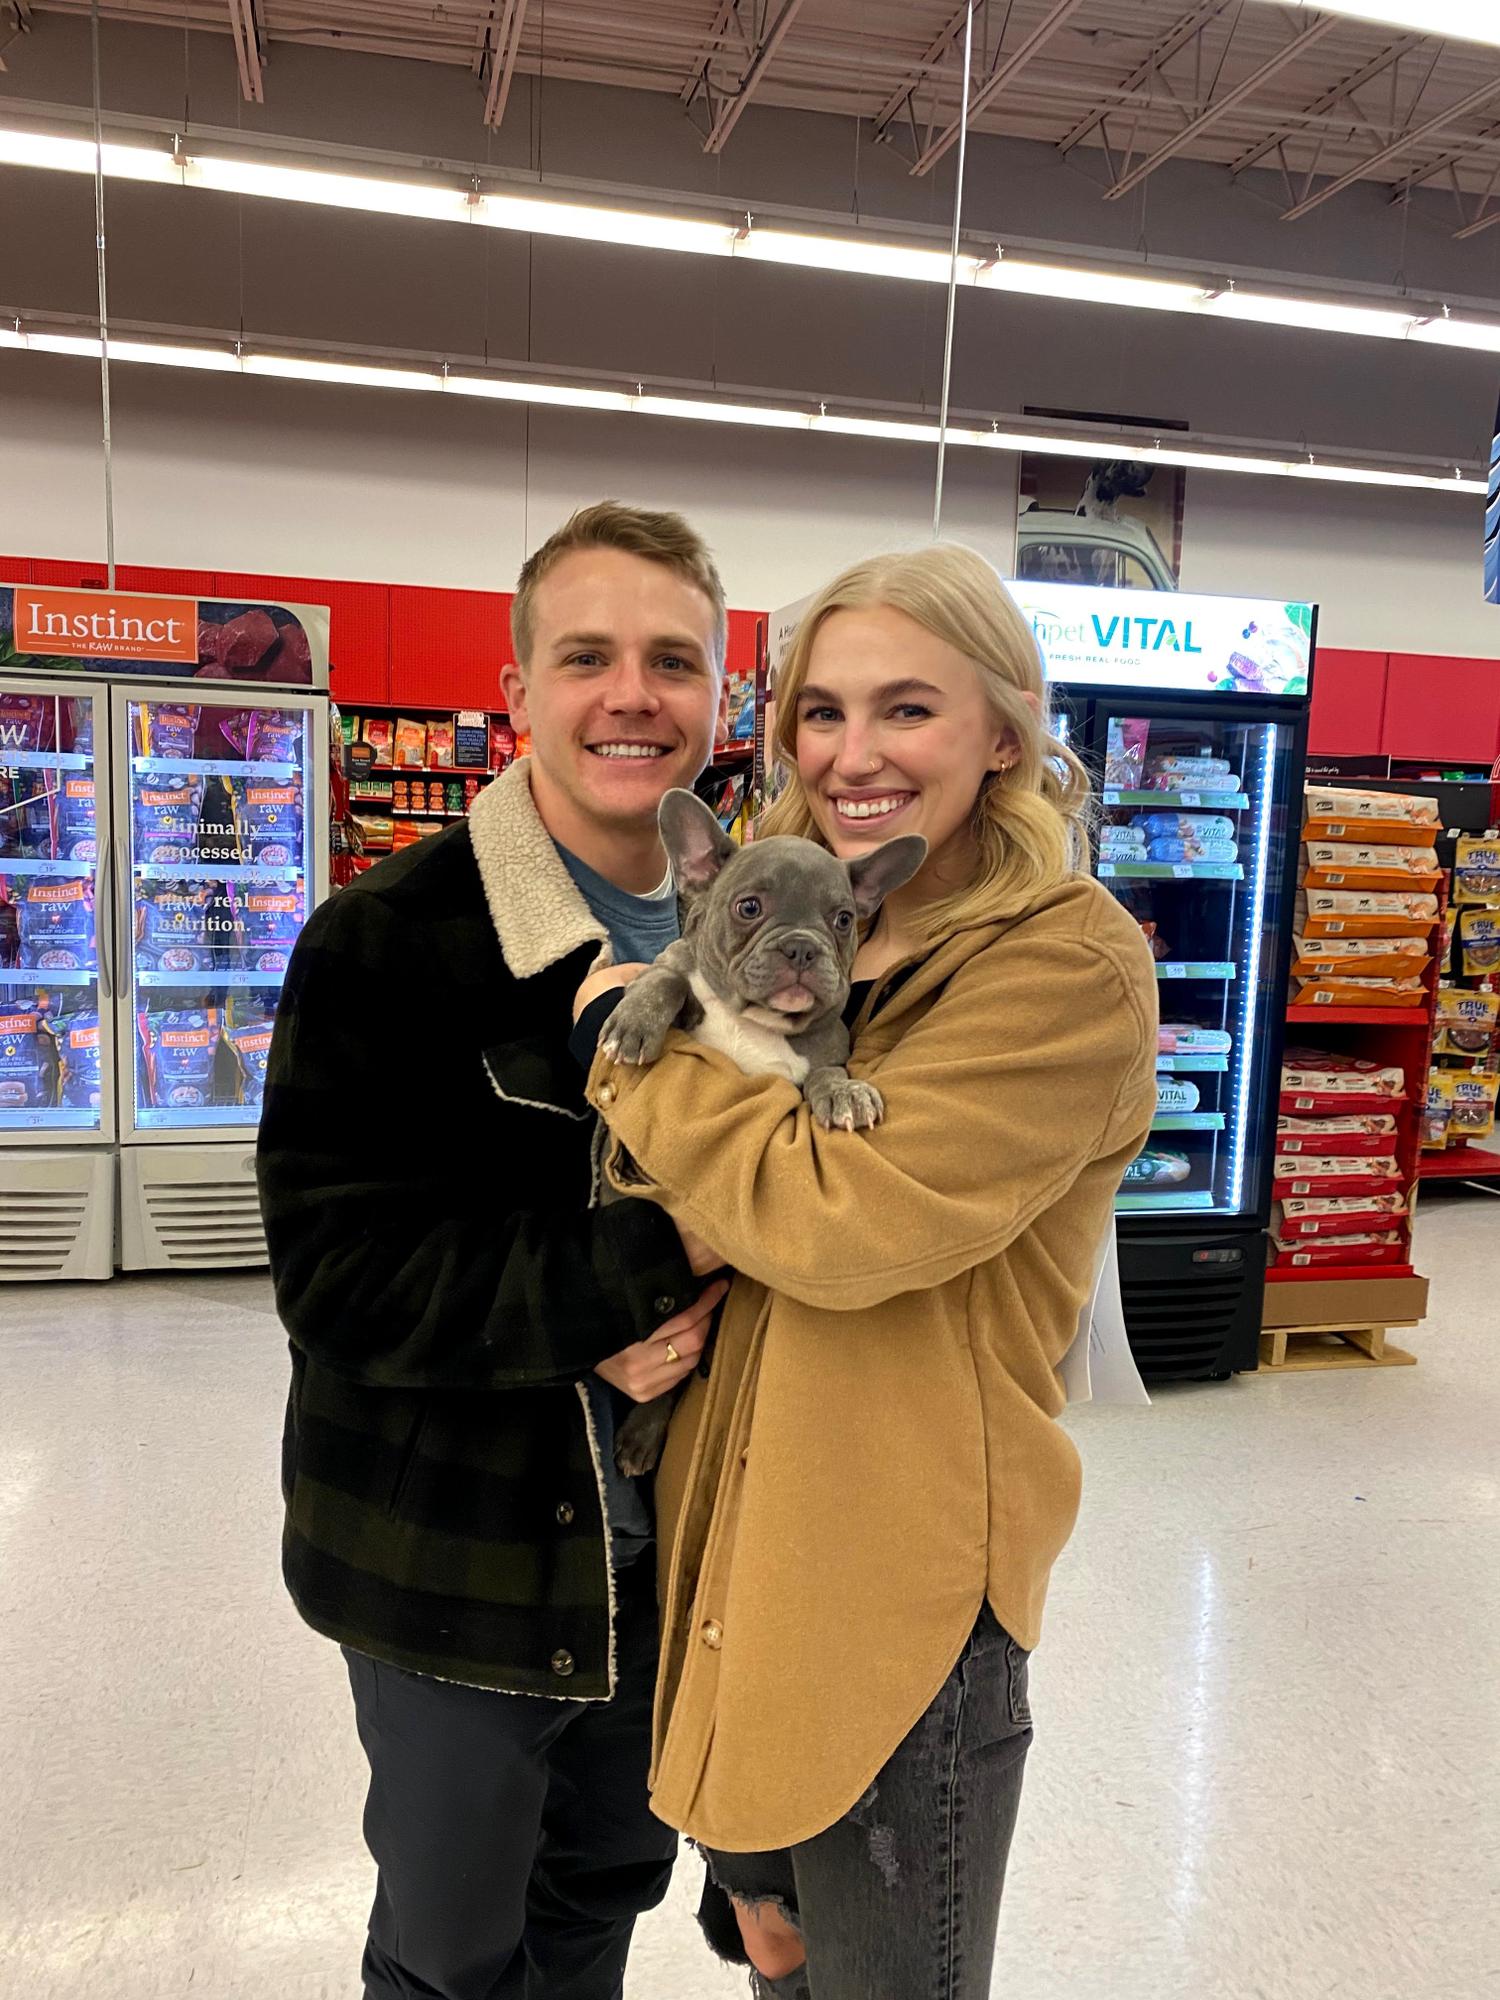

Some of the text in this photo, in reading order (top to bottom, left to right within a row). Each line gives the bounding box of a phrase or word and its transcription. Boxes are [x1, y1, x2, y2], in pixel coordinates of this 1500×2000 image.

[27, 602, 185, 644] Instinct
[1091, 614, 1202, 653] VITAL
[88, 642, 113, 652] RAW
[114, 645, 144, 653] BRAND
[1085, 655, 1110, 664] REAL
[146, 792, 185, 802] Instinct
[251, 790, 290, 800] Instinct
[154, 806, 180, 815] raw
[259, 804, 284, 813] raw
[166, 818, 260, 841] inimally
[1116, 830, 1136, 839] VITAL
[1116, 854, 1136, 863] VITAL
[32, 886, 79, 898] Instinct
[213, 892, 249, 908] real
[253, 897, 290, 907] Instinct
[40, 902, 72, 913] raw
[165, 902, 194, 911] raw
[260, 912, 282, 921] raw
[1470, 921, 1496, 930] TRUE
[1457, 1001, 1489, 1013] TRUE
[166, 1034, 205, 1043] Instinct
[173, 1048, 198, 1057] raw
[1456, 1083, 1485, 1094] TRUE
[1158, 1090, 1187, 1100] VITAL
